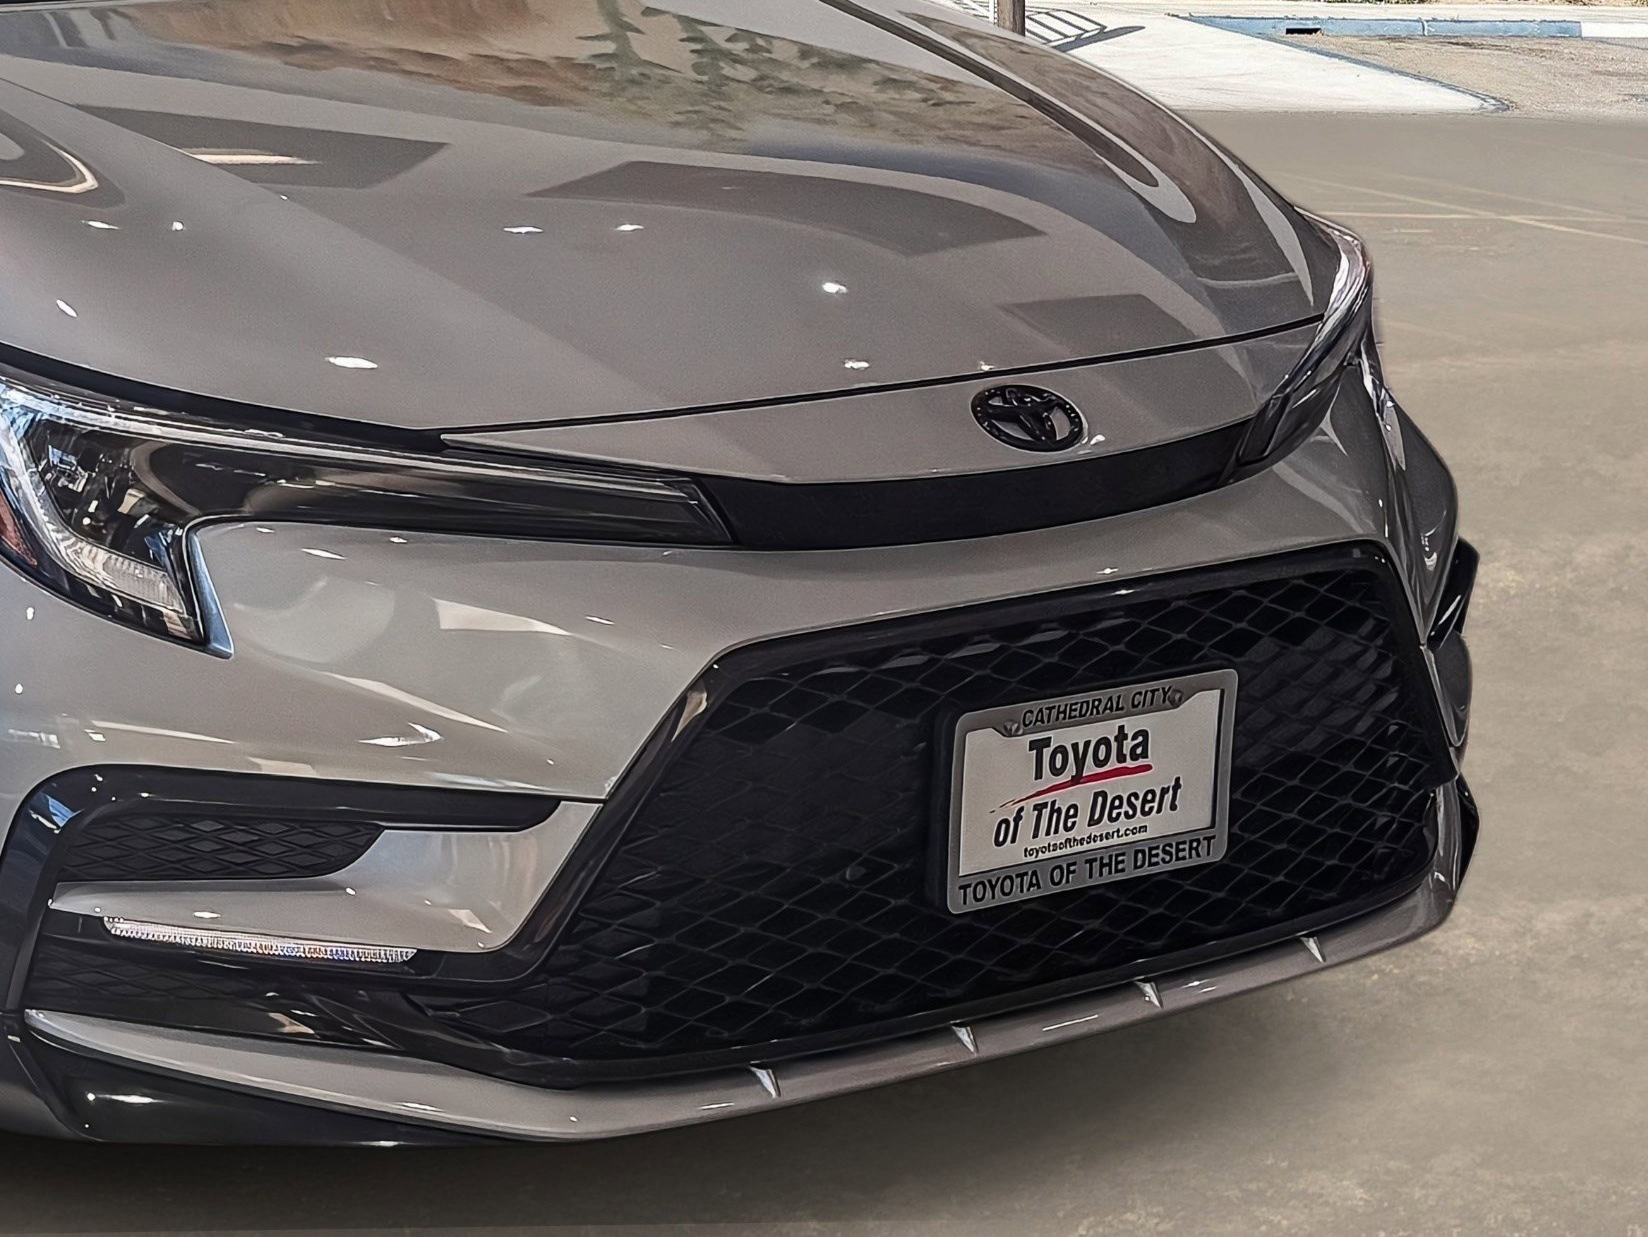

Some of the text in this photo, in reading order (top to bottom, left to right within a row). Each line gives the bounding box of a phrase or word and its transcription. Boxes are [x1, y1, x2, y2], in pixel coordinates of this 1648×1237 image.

[1022, 686, 1173, 728] CATHEDRAL CITY
[1028, 724, 1150, 785] Toyota
[993, 776, 1182, 848] of The Desert
[958, 835, 1217, 905] TOYOTA OF THE DESERT
